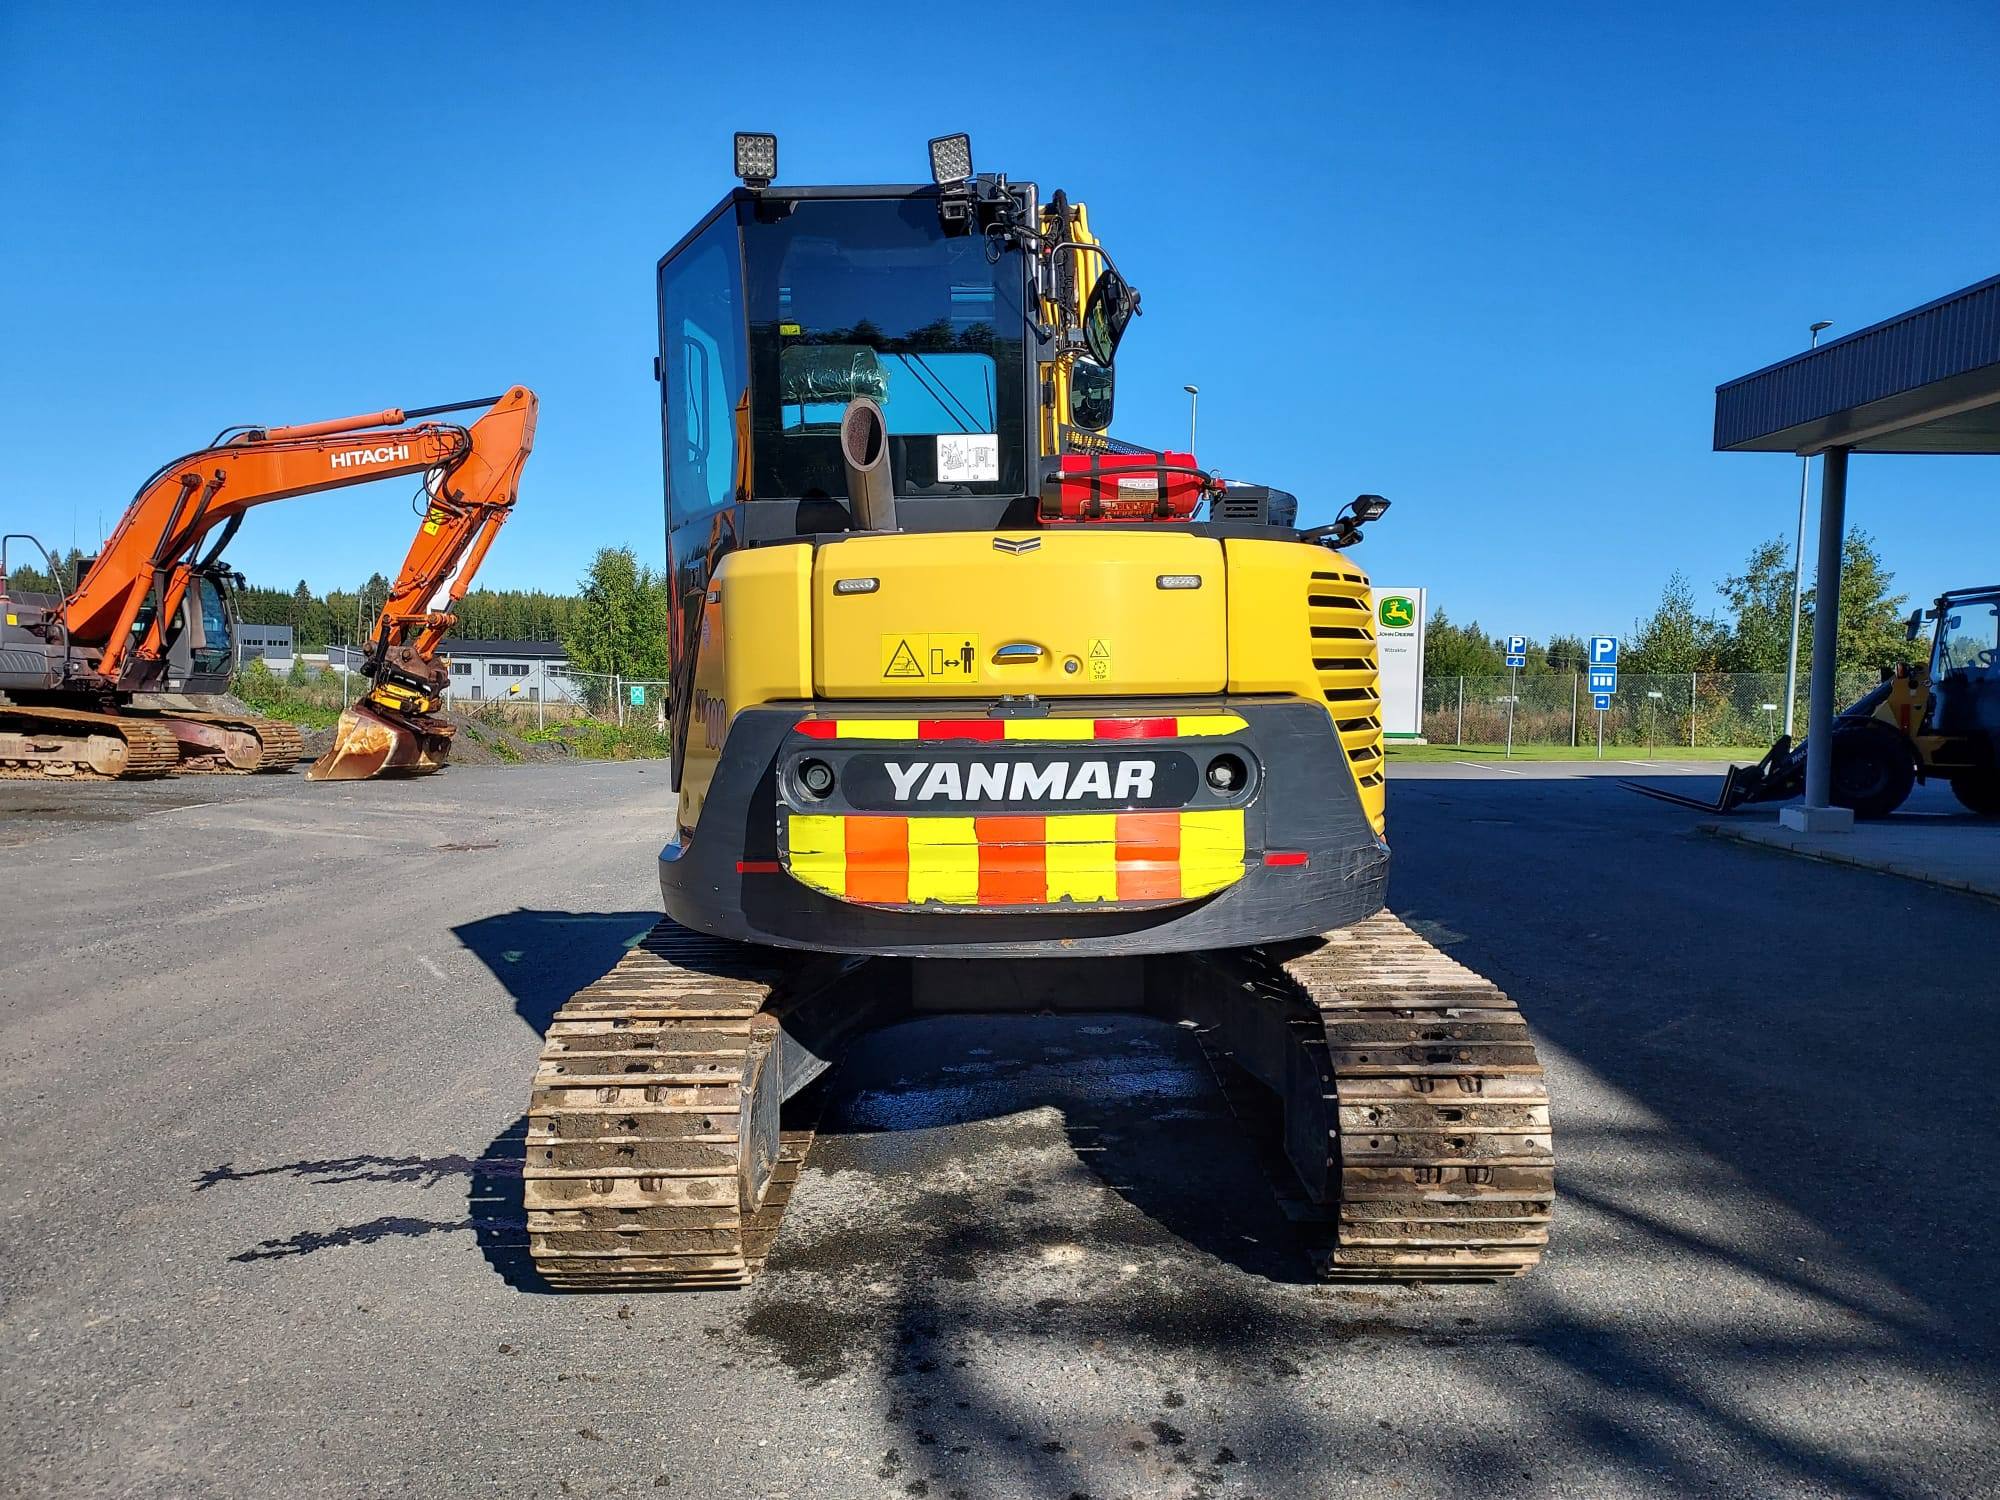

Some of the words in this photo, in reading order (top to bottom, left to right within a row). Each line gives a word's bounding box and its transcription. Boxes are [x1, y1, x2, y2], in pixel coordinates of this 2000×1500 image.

[331, 445, 409, 468] HITACHI
[1511, 638, 1523, 652] P
[1595, 639, 1613, 662] P
[884, 761, 1156, 800] YANMAR
